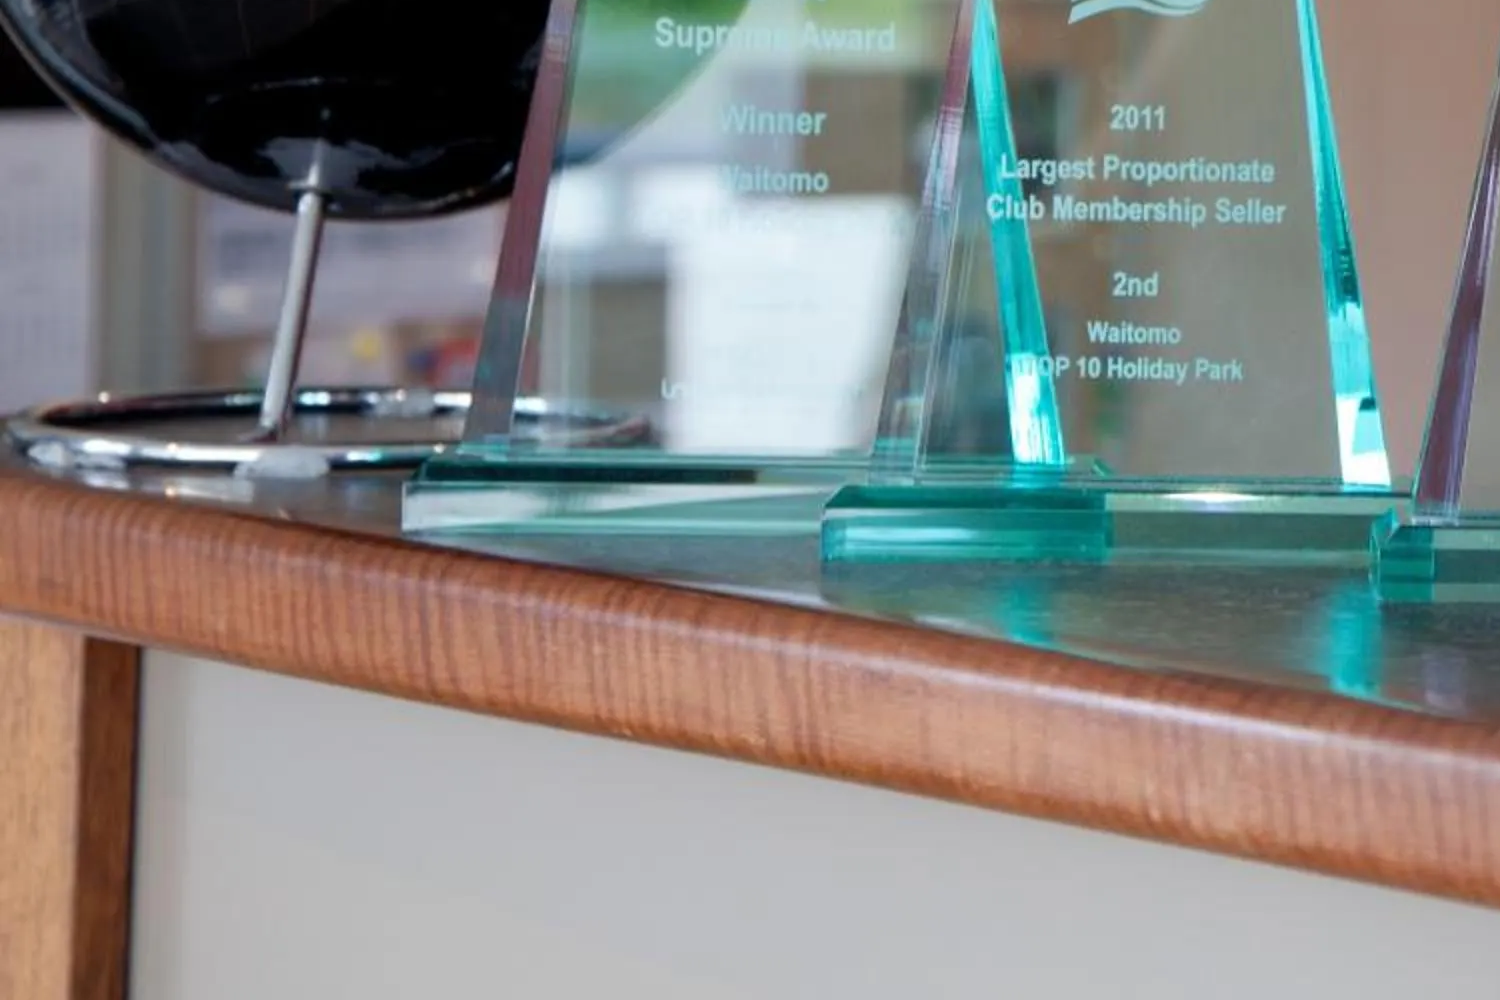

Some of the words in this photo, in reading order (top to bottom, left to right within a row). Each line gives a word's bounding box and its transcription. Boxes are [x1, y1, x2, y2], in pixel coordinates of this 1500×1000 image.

[801, 21, 896, 51] Award
[717, 105, 826, 134] Winner
[1110, 104, 1165, 131] 2011
[1000, 153, 1095, 185] Largest
[1103, 154, 1275, 187] Proportionate
[986, 192, 1045, 220] Club
[1053, 195, 1206, 228] Membership
[1215, 198, 1286, 224] Seller
[1112, 272, 1159, 297] 2nd
[1087, 321, 1182, 345] Waitomo
[1076, 356, 1101, 379] 10
[1107, 355, 1188, 386] Holiday
[1194, 358, 1243, 381] Park
